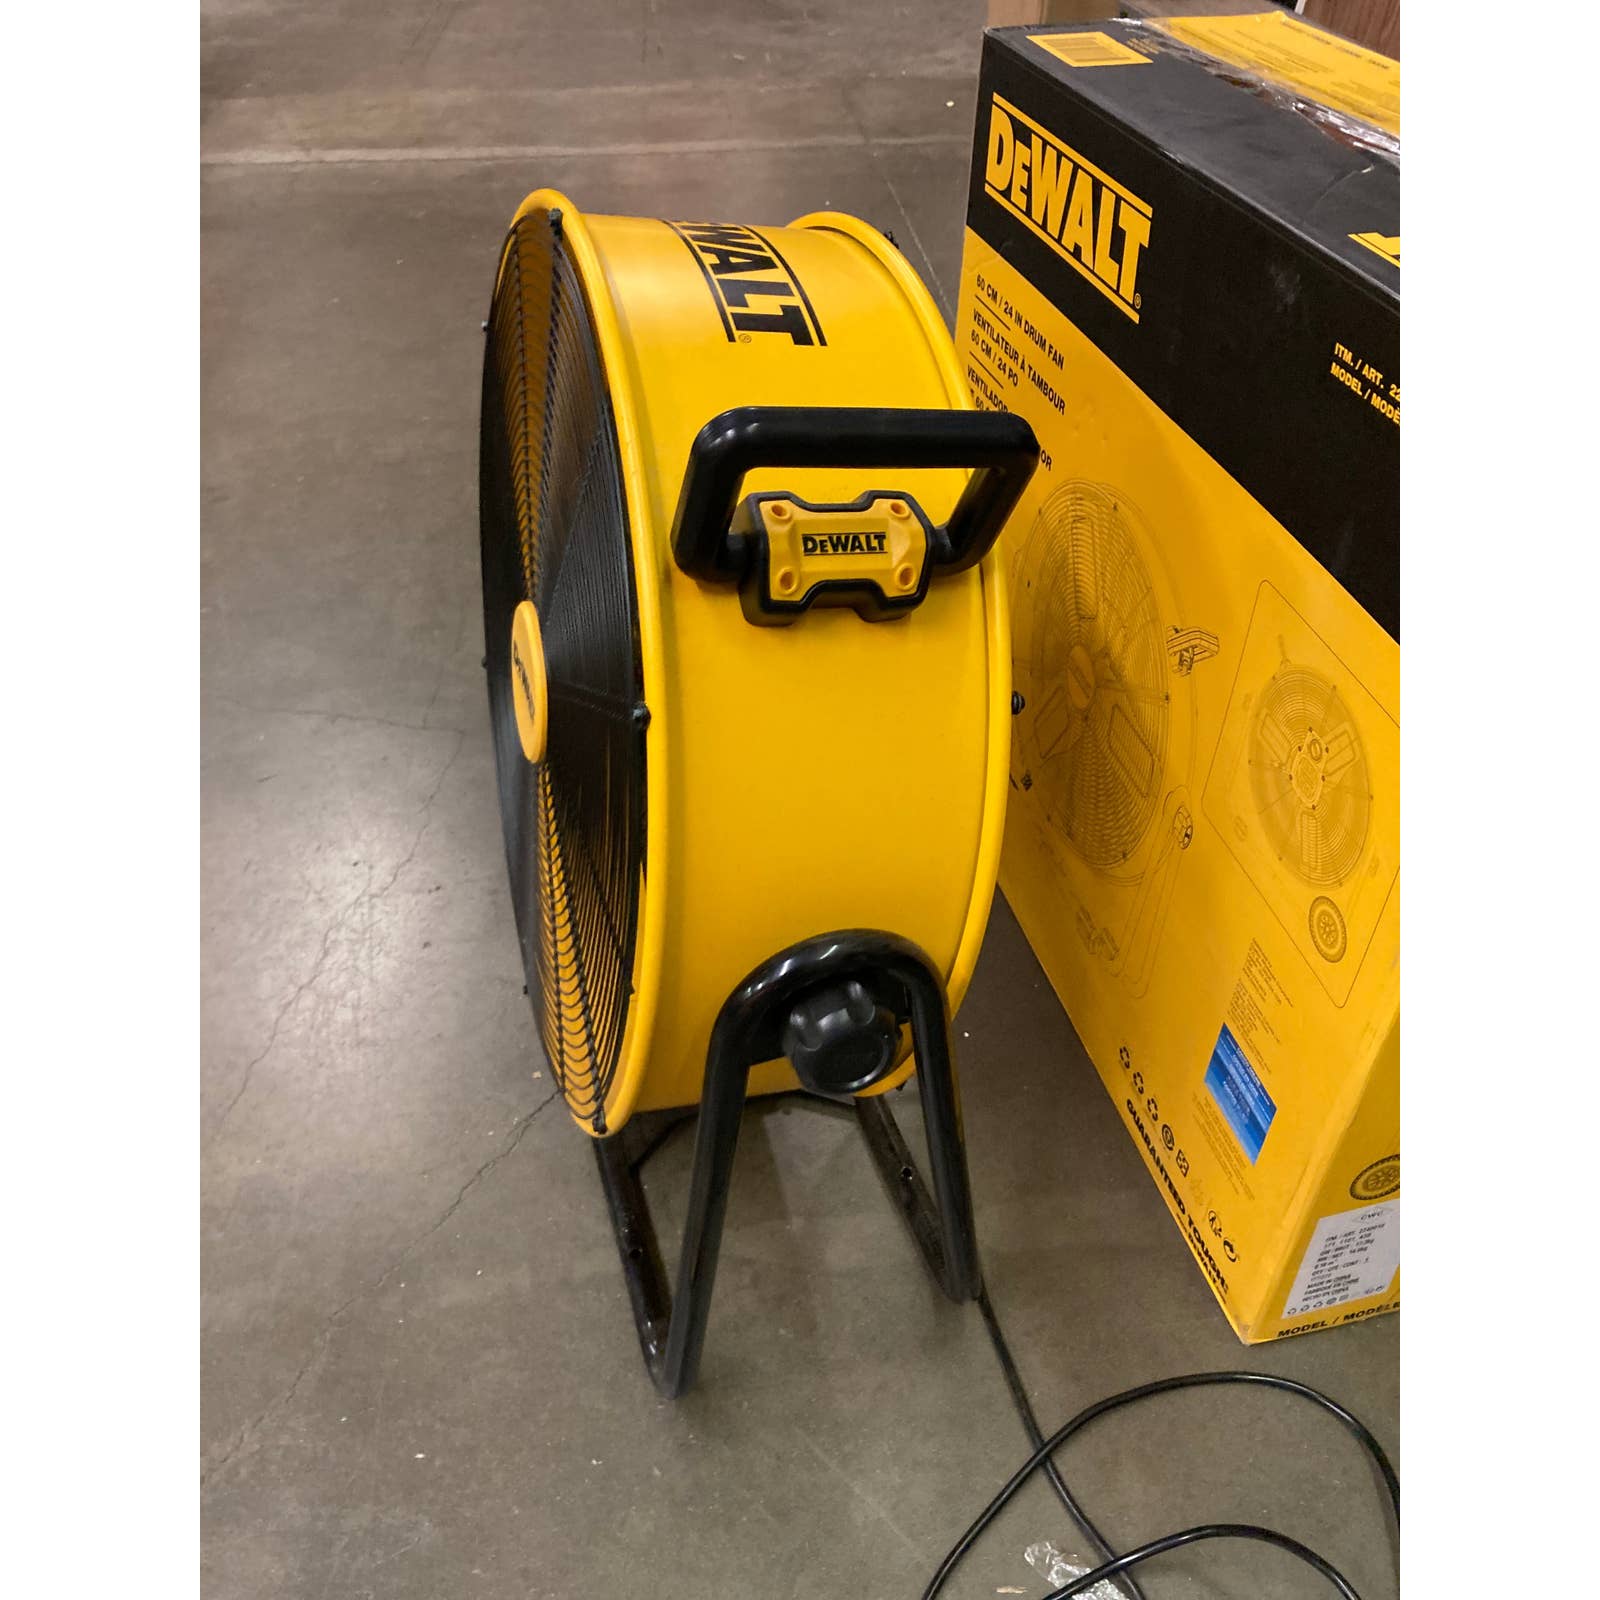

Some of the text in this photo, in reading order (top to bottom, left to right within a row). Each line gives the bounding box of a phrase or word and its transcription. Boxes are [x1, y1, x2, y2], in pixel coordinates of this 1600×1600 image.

[976, 274, 1065, 370] 60 CM / 24 IN DRUM FAN
[971, 329, 980, 346] 60
[981, 339, 992, 359] CM
[997, 357, 1007, 375] 24
[1008, 367, 1018, 387] PO
[973, 308, 1019, 365] VENTILATEUR
[1028, 364, 1065, 415] TAMBOUR
[1330, 361, 1363, 396] MODEL
[1364, 388, 1371, 400] /
[1334, 342, 1353, 366] ITM.
[1355, 359, 1362, 370] /
[1362, 363, 1384, 389] ART.
[1126, 1098, 1185, 1215] GUARANTEED
[1277, 1320, 1328, 1337] MODEL
[1332, 1316, 1340, 1324] /
